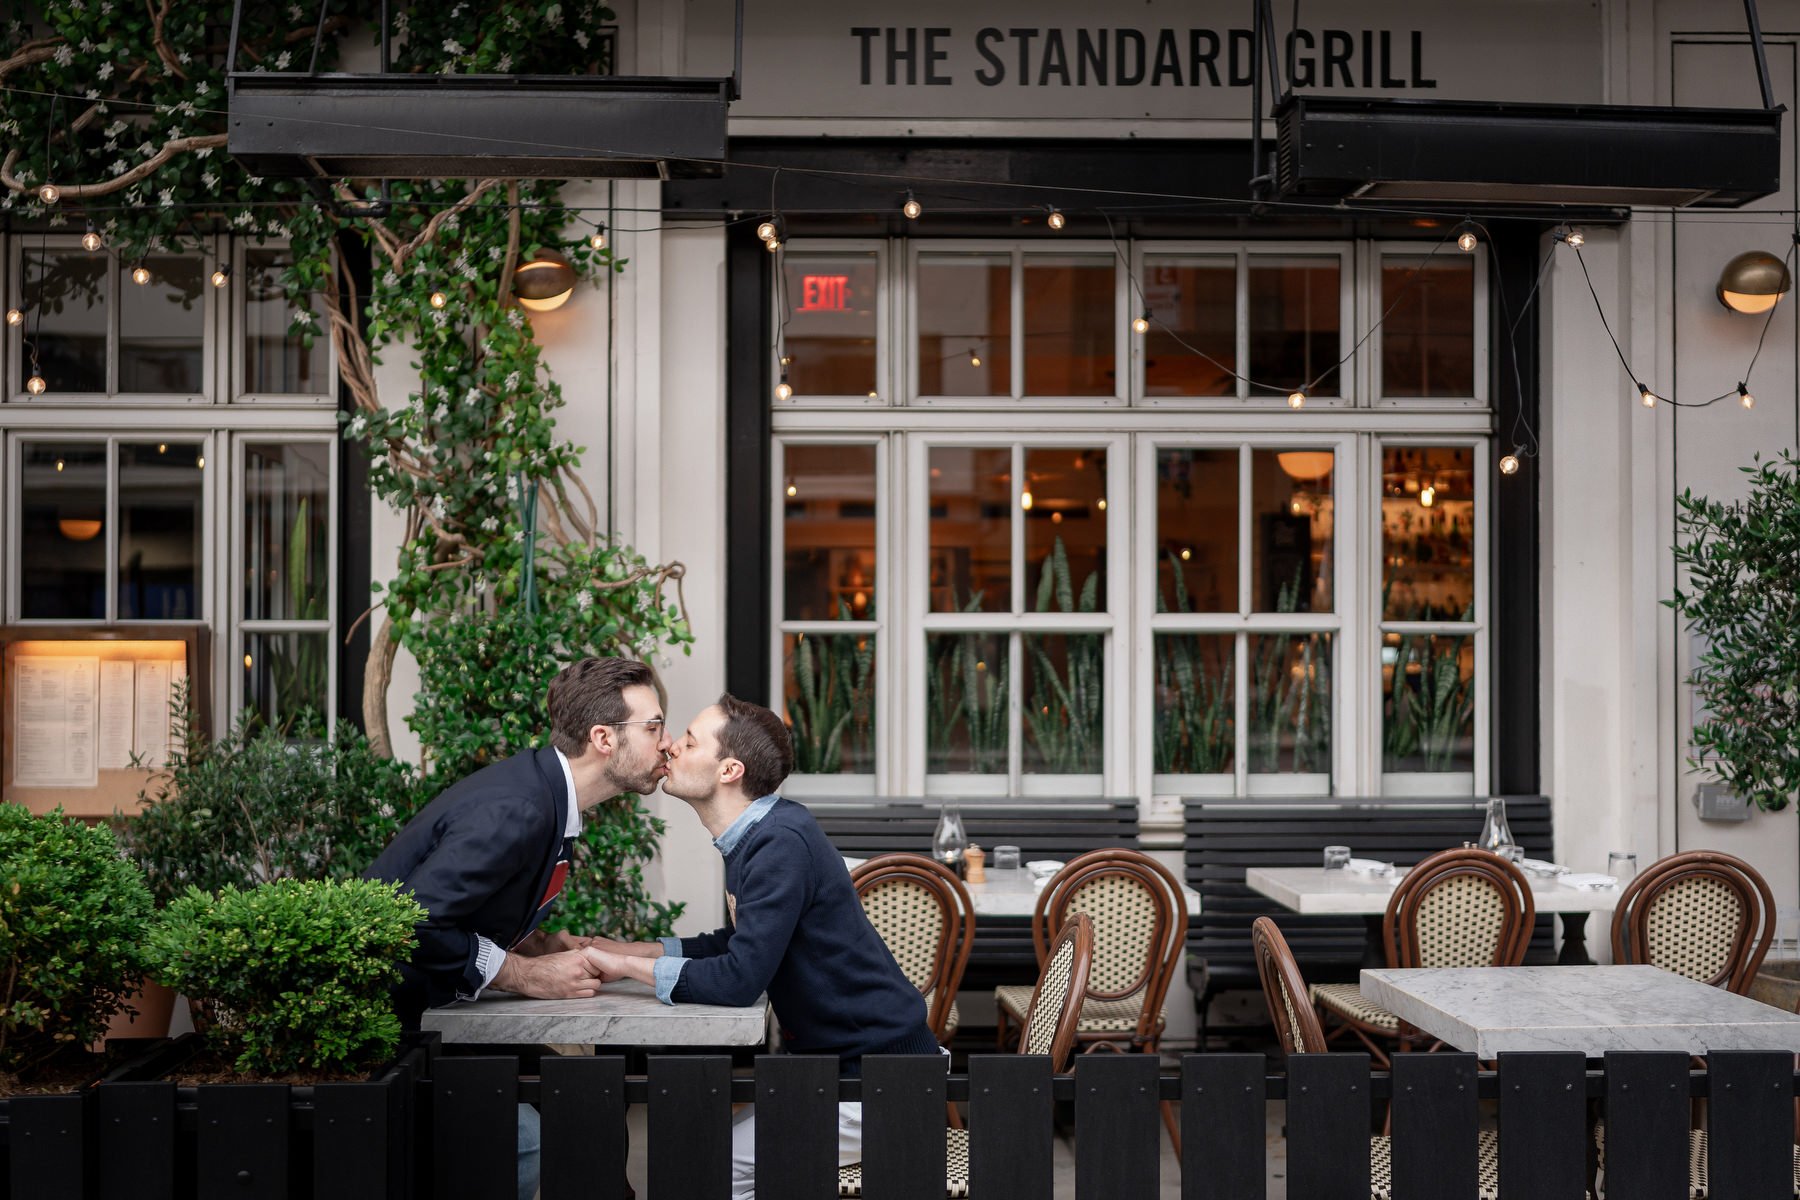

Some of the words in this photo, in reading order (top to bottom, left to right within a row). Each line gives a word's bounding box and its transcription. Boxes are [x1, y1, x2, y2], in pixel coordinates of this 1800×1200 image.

[850, 27, 952, 86] THE
[974, 27, 1255, 87] STANDARD
[1285, 28, 1437, 88] GRILL
[802, 274, 848, 310] EXIT
